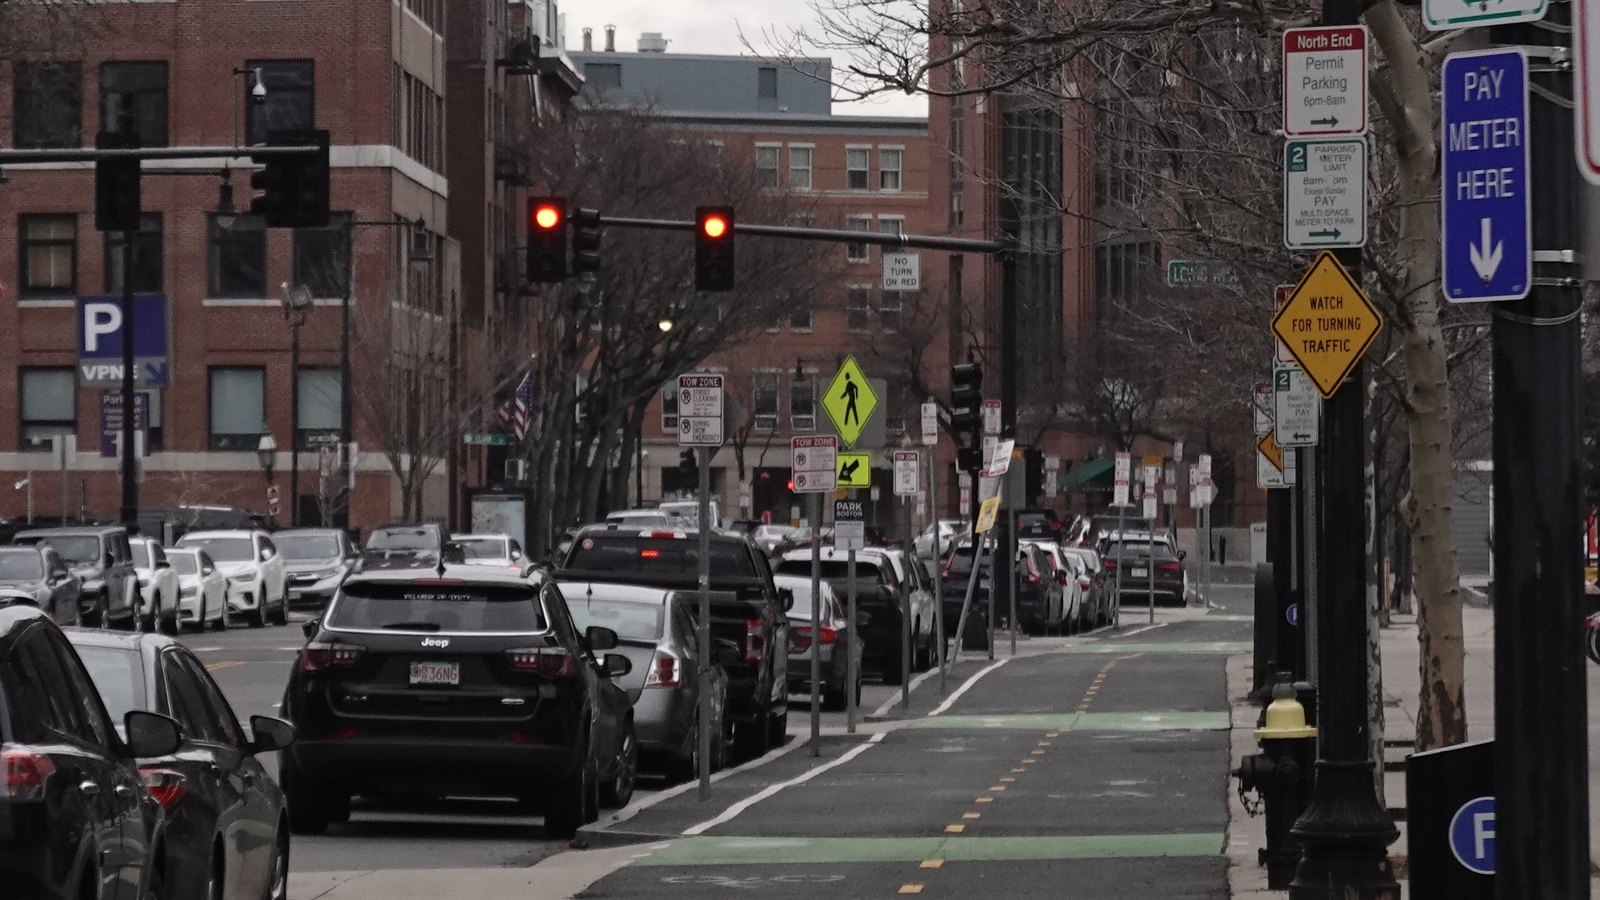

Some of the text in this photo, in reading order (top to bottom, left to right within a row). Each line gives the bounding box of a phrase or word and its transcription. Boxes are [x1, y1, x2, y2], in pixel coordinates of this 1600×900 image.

[1297, 33, 1353, 50] North End
[1305, 56, 1344, 71] Permit
[1302, 76, 1348, 92] Parking
[1463, 69, 1505, 103] PAY
[1303, 95, 1346, 107] 6pm-8am
[1449, 117, 1521, 153] METER
[1292, 145, 1356, 163] 2 PARKING
[1320, 154, 1352, 162] METER
[1323, 163, 1348, 172] LIMIT
[1456, 167, 1515, 201] HERE
[1314, 196, 1337, 207] PAY
[1295, 216, 1354, 226] METER TO PARK
[894, 257, 908, 265] NO
[891, 267, 912, 276] TURN
[886, 278, 917, 287] ON RED
[1309, 296, 1343, 311] WATCH
[84, 303, 122, 352] P
[1291, 316, 1361, 333] FOR TURNING
[1302, 338, 1350, 354] TRAFFIC
[682, 377, 719, 387] TOW ZONE
[1279, 373, 1289, 386] 2
[1295, 408, 1312, 417] PAY
[796, 437, 834, 447] TOW ZONE
[836, 502, 862, 511] PARK
[421, 638, 449, 648] Jeep
